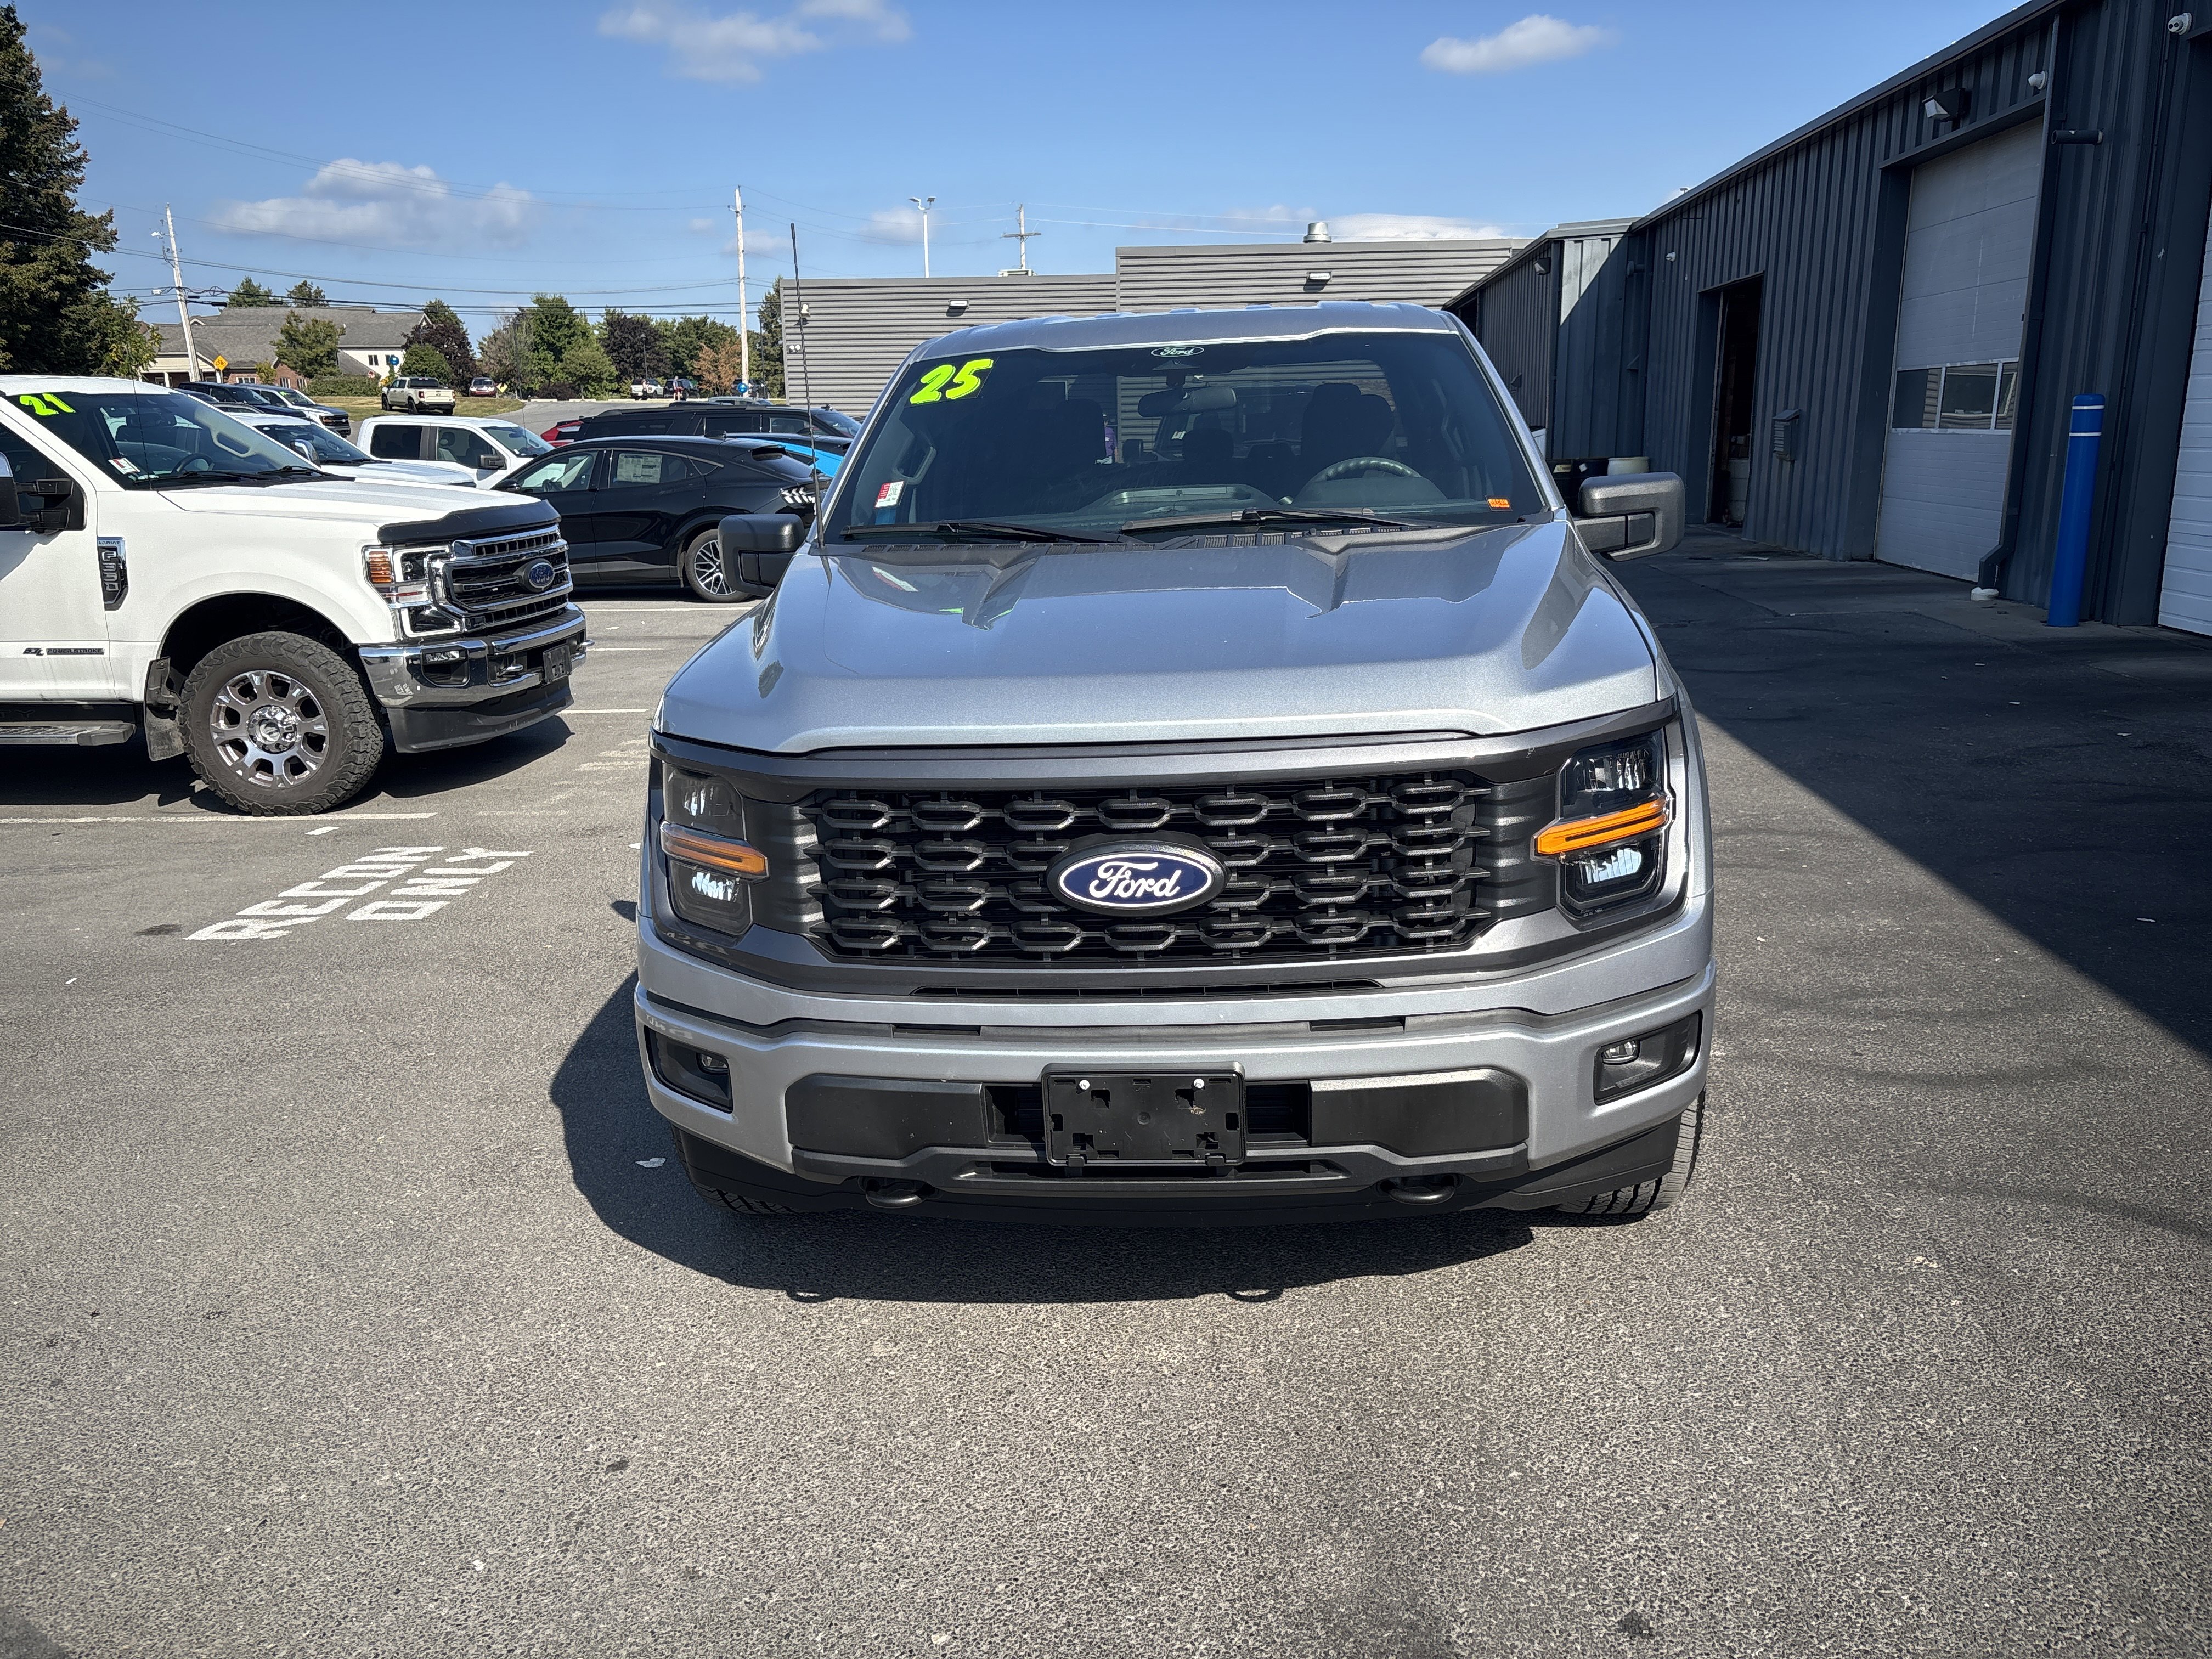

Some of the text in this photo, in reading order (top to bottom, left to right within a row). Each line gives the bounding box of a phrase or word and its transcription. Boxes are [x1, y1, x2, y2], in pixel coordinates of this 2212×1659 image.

[1160, 347, 1195, 356] Ford
[910, 359, 994, 404] 25
[20, 393, 76, 415] 21
[102, 551, 119, 591] F350
[183, 847, 444, 940] RECON
[346, 848, 534, 921] ONLY
[1089, 861, 1182, 898] Ford
